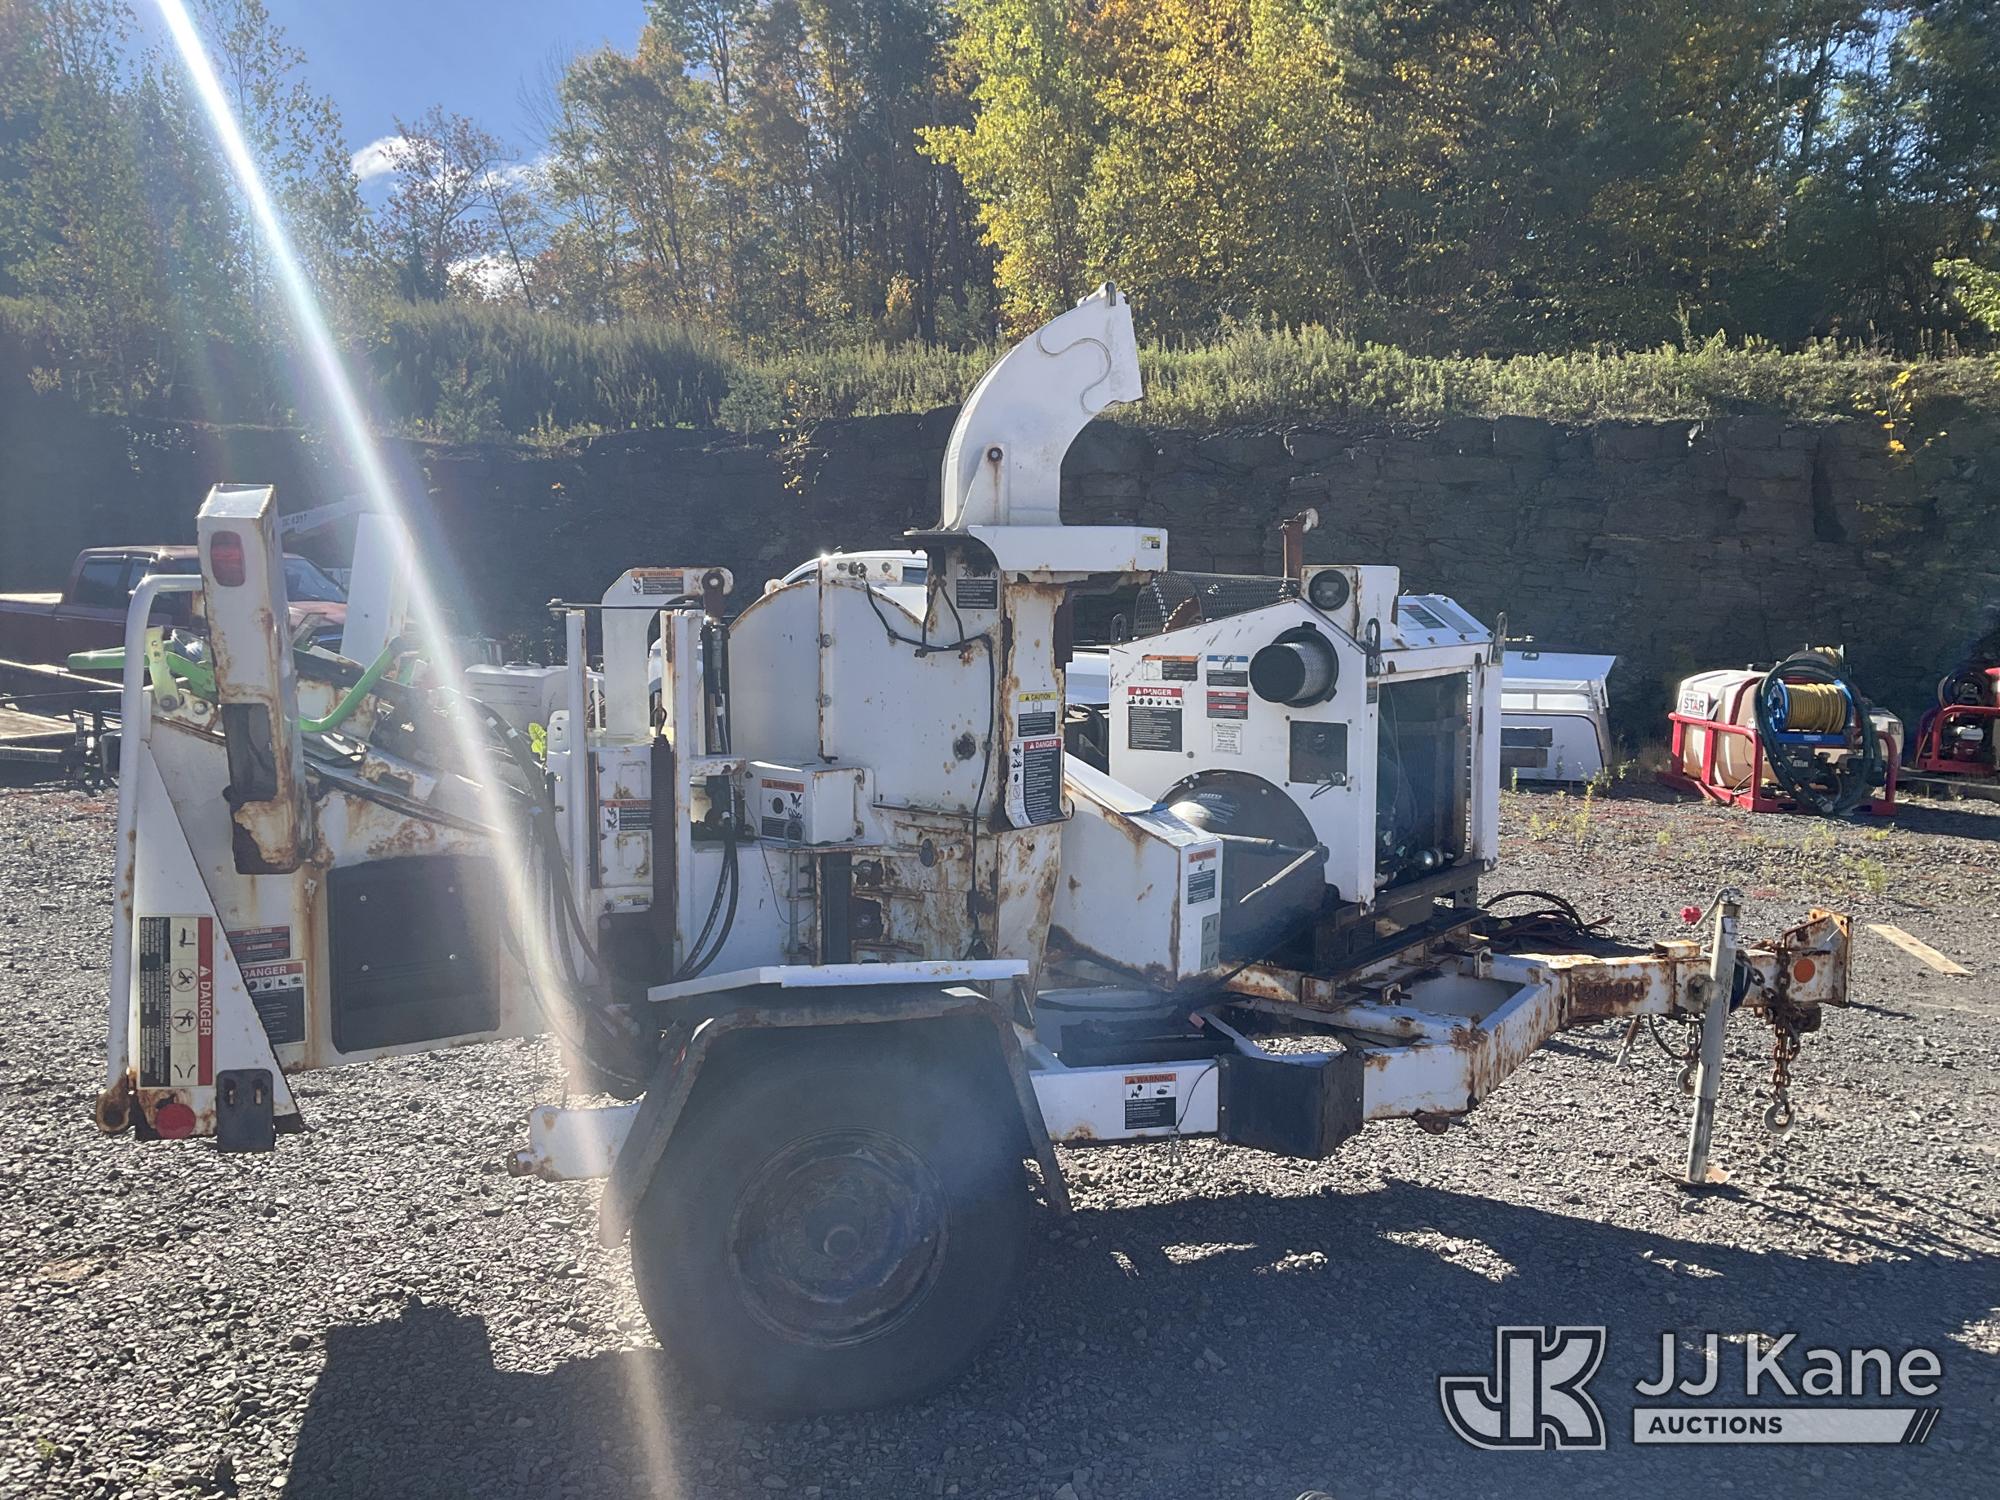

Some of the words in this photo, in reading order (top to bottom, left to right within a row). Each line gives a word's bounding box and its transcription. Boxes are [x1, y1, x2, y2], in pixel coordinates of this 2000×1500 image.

[1683, 697, 1705, 712] STAR
[1035, 740, 1057, 749] DANGER
[199, 981, 211, 1036] DANGER
